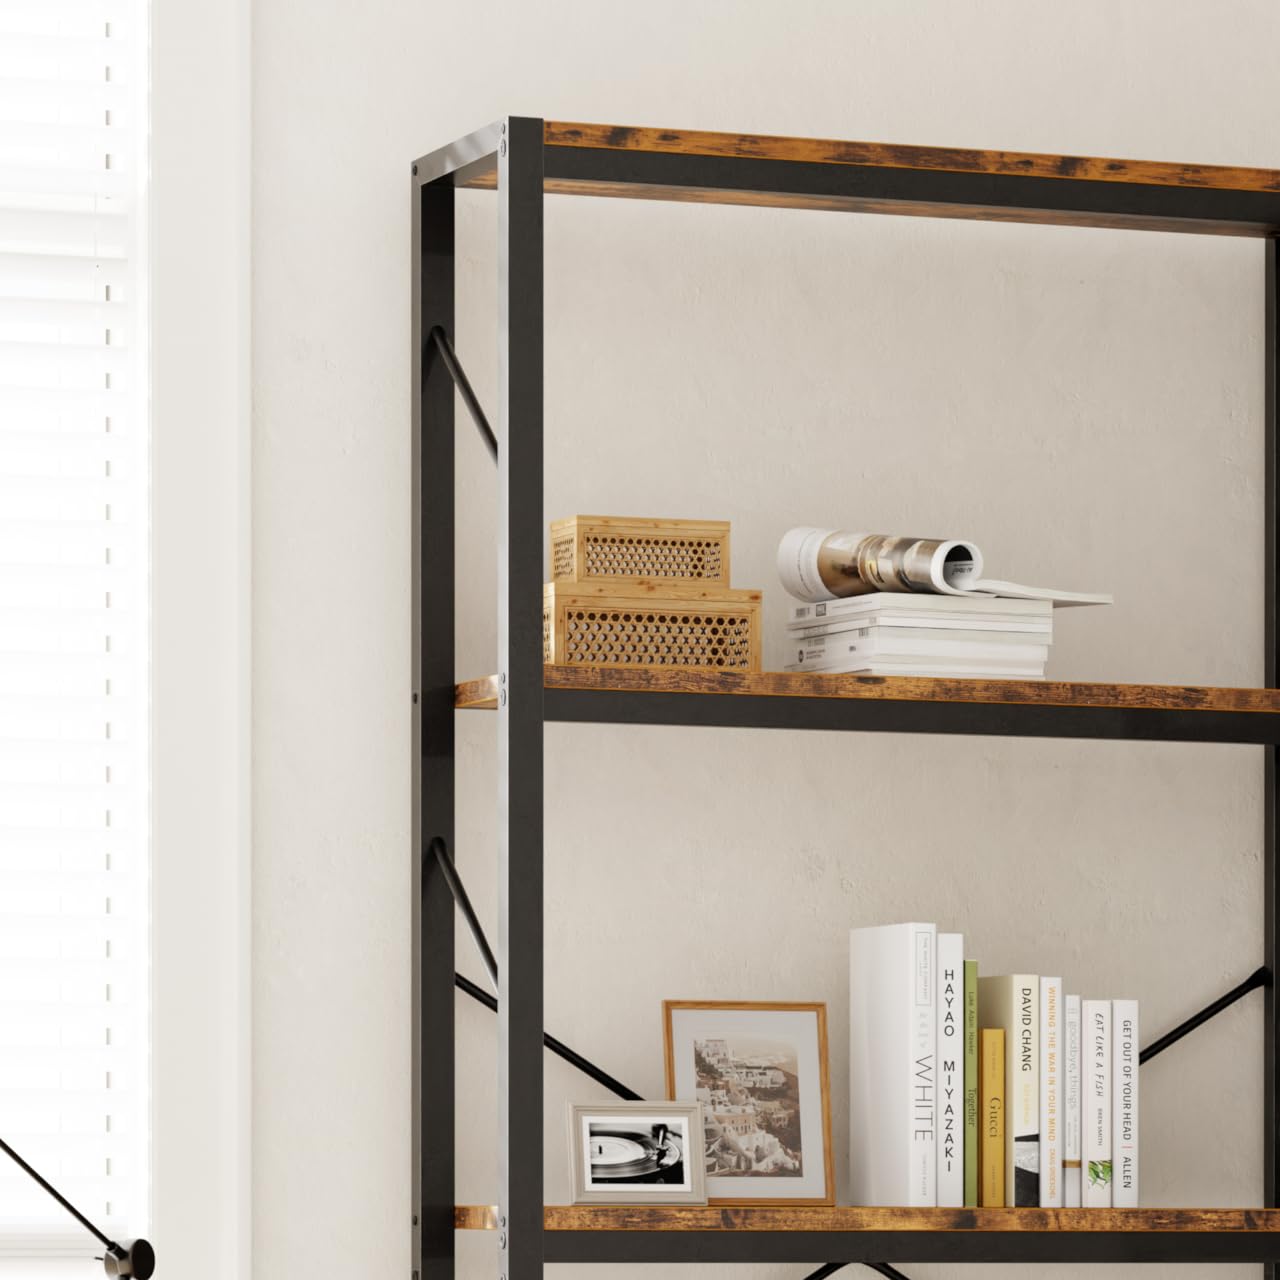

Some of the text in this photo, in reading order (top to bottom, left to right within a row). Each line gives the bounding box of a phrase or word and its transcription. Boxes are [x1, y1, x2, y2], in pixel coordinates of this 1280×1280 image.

[944, 969, 955, 1037] HAYAO
[1021, 988, 1032, 1026] DAVID
[1095, 1013, 1104, 1034] EAT
[1021, 1029, 1032, 1072] CHANG
[1048, 986, 1056, 1142] WINNING THE WAR IN YOUR MIND
[1095, 1036, 1104, 1057] LIKE
[914, 1054, 934, 1142] WHITE
[1068, 1075, 1078, 1110] things
[1095, 1073, 1104, 1097] FISH
[1122, 1020, 1132, 1141] GET OUT OF YOUR HEAD
[943, 1060, 956, 1172] MIYAZAKI
[967, 1088, 976, 1128] Together
[989, 1096, 1001, 1138] Gucci
[1122, 1156, 1132, 1189] ALLEN
